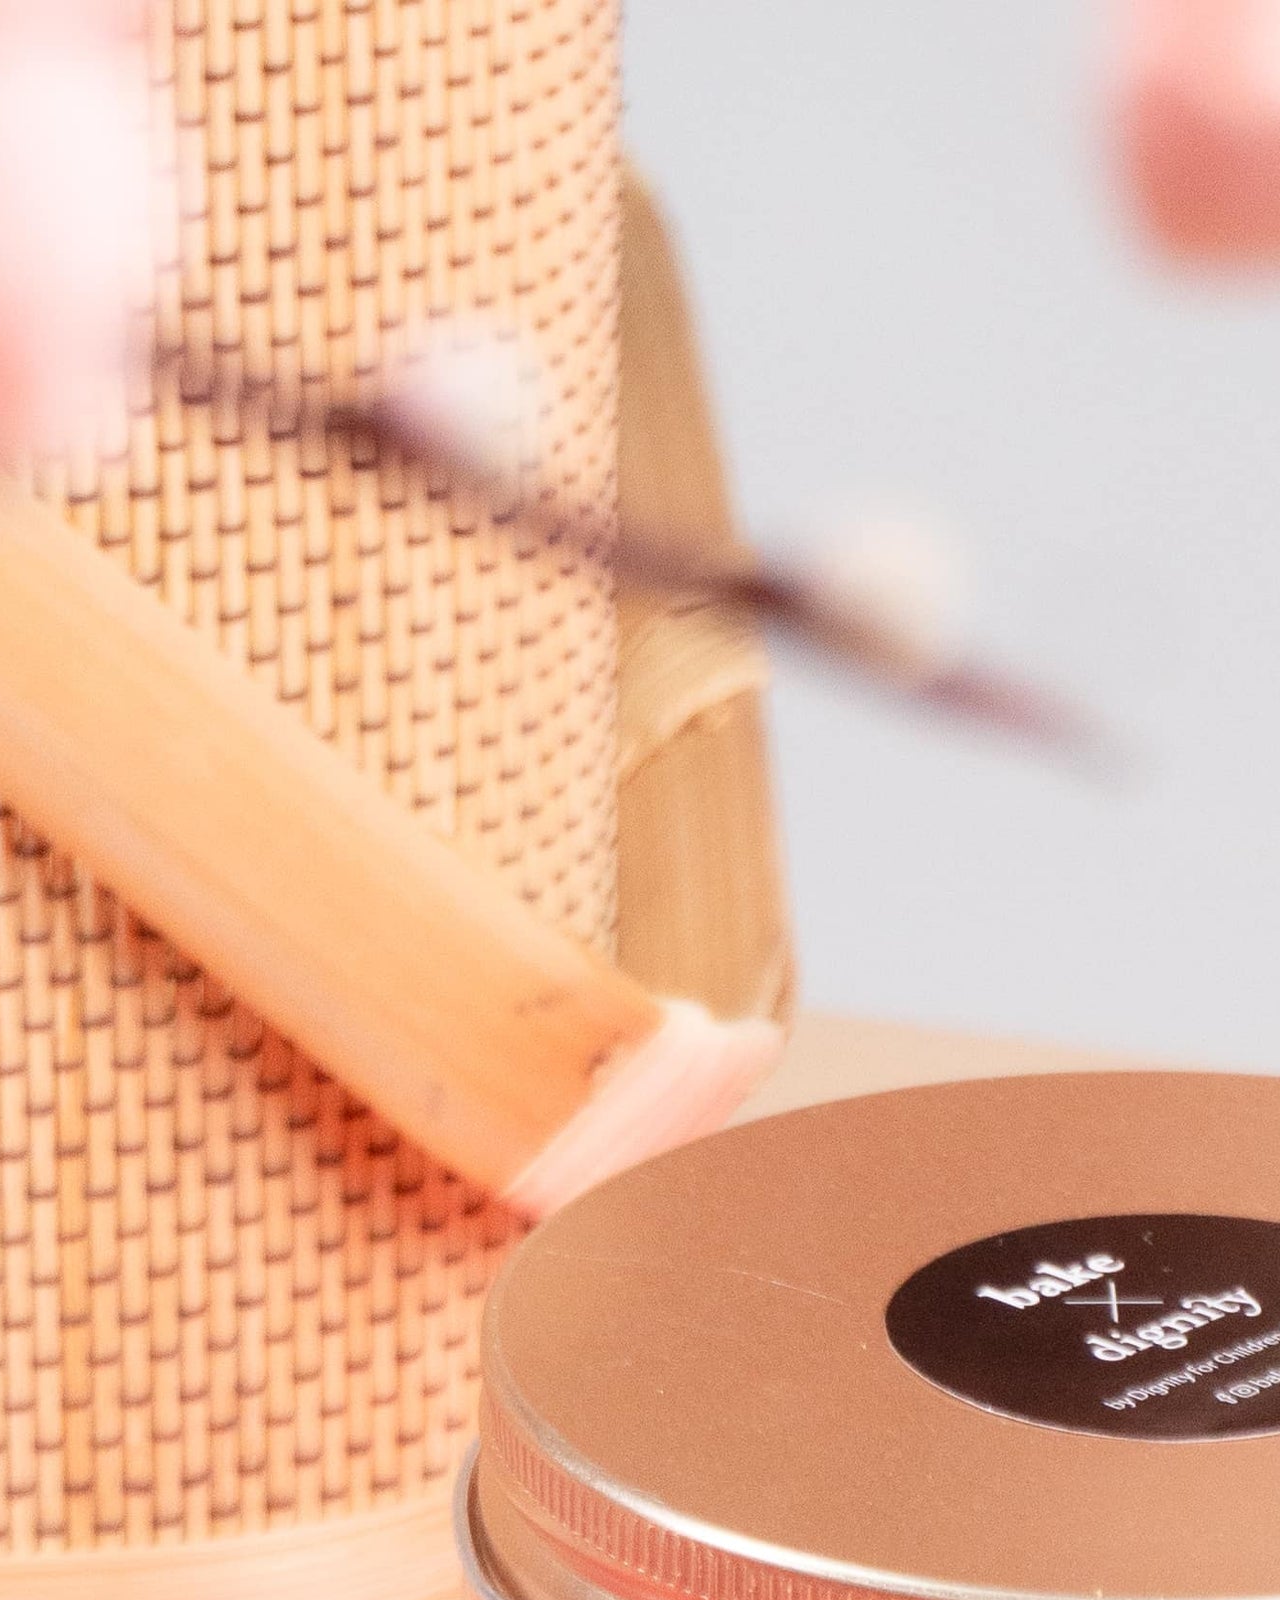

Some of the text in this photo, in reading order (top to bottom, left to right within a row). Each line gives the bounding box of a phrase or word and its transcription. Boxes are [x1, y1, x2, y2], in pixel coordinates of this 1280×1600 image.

[976, 1252, 1125, 1311] bake
[1085, 1285, 1263, 1363] dignity
[1103, 1396, 1136, 1411] by
[1128, 1369, 1197, 1402] Dignity
[1189, 1359, 1219, 1377] for
